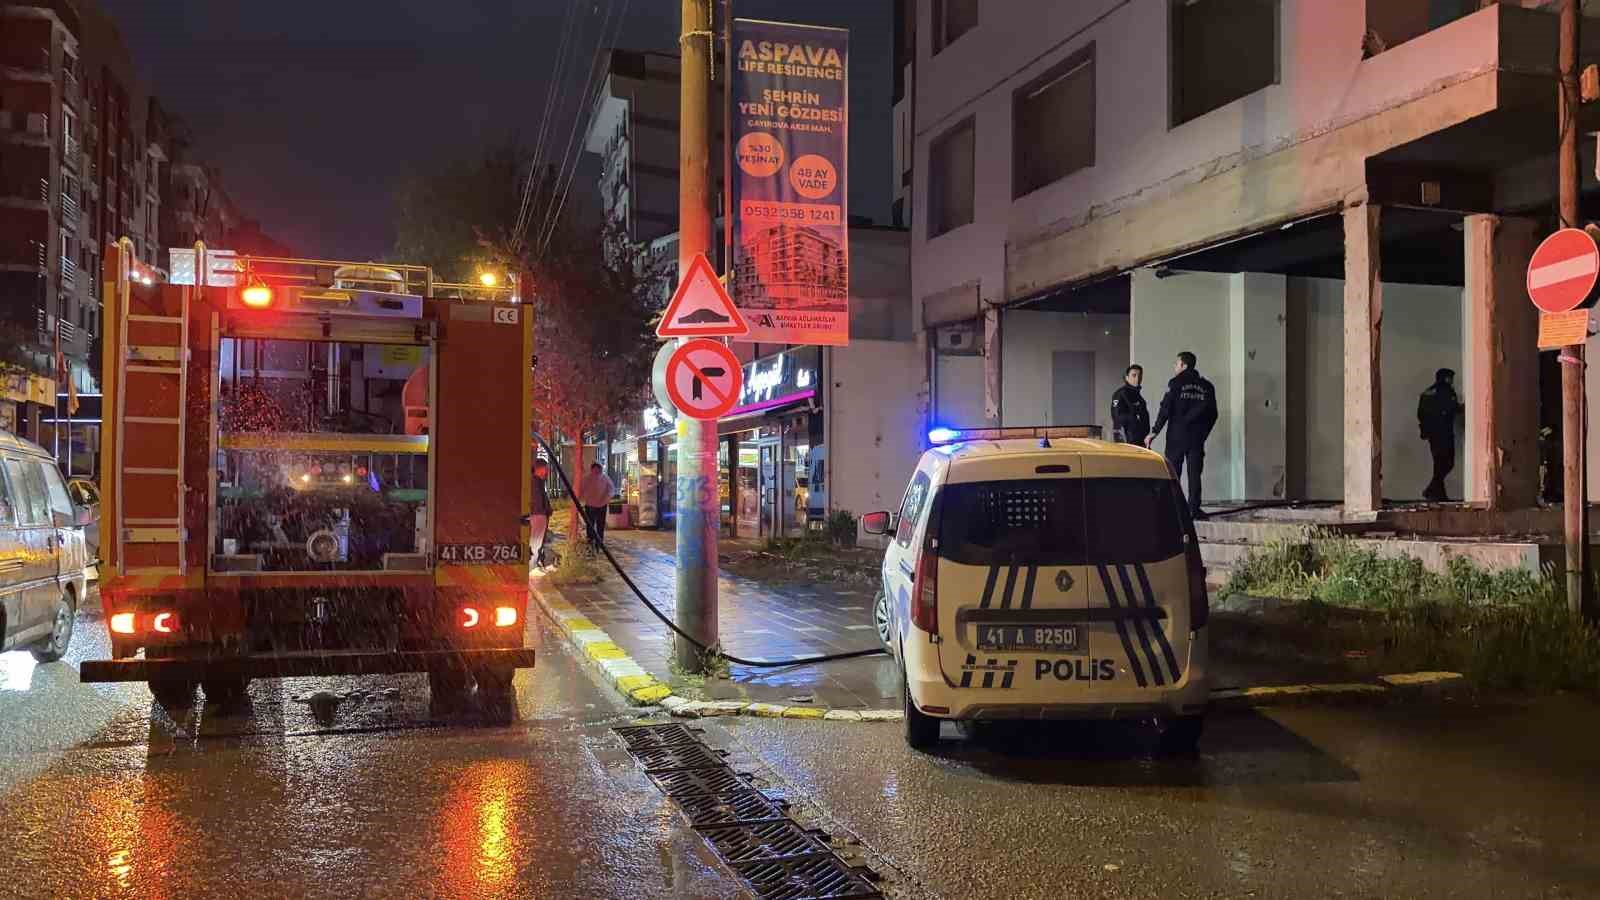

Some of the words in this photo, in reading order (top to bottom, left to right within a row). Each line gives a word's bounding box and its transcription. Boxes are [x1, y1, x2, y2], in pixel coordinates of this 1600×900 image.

[739, 40, 842, 68] ASPAVA
[738, 60, 765, 73] LIFE
[767, 63, 842, 80] RESIDENCE
[763, 89, 820, 105] ŞEHRİN
[739, 102, 774, 117] YENİ
[777, 104, 843, 122] GÖZDESİ
[797, 168, 812, 178] 48
[815, 169, 828, 179] AY
[800, 180, 828, 190] VADE
[744, 206, 778, 217] 0532
[810, 209, 835, 220] 1241
[497, 310, 515, 321] CE
[441, 546, 457, 560] 41
[463, 546, 486, 560] KB
[491, 545, 519, 560] 764
[986, 628, 1004, 645] 41
[1016, 629, 1025, 644] A
